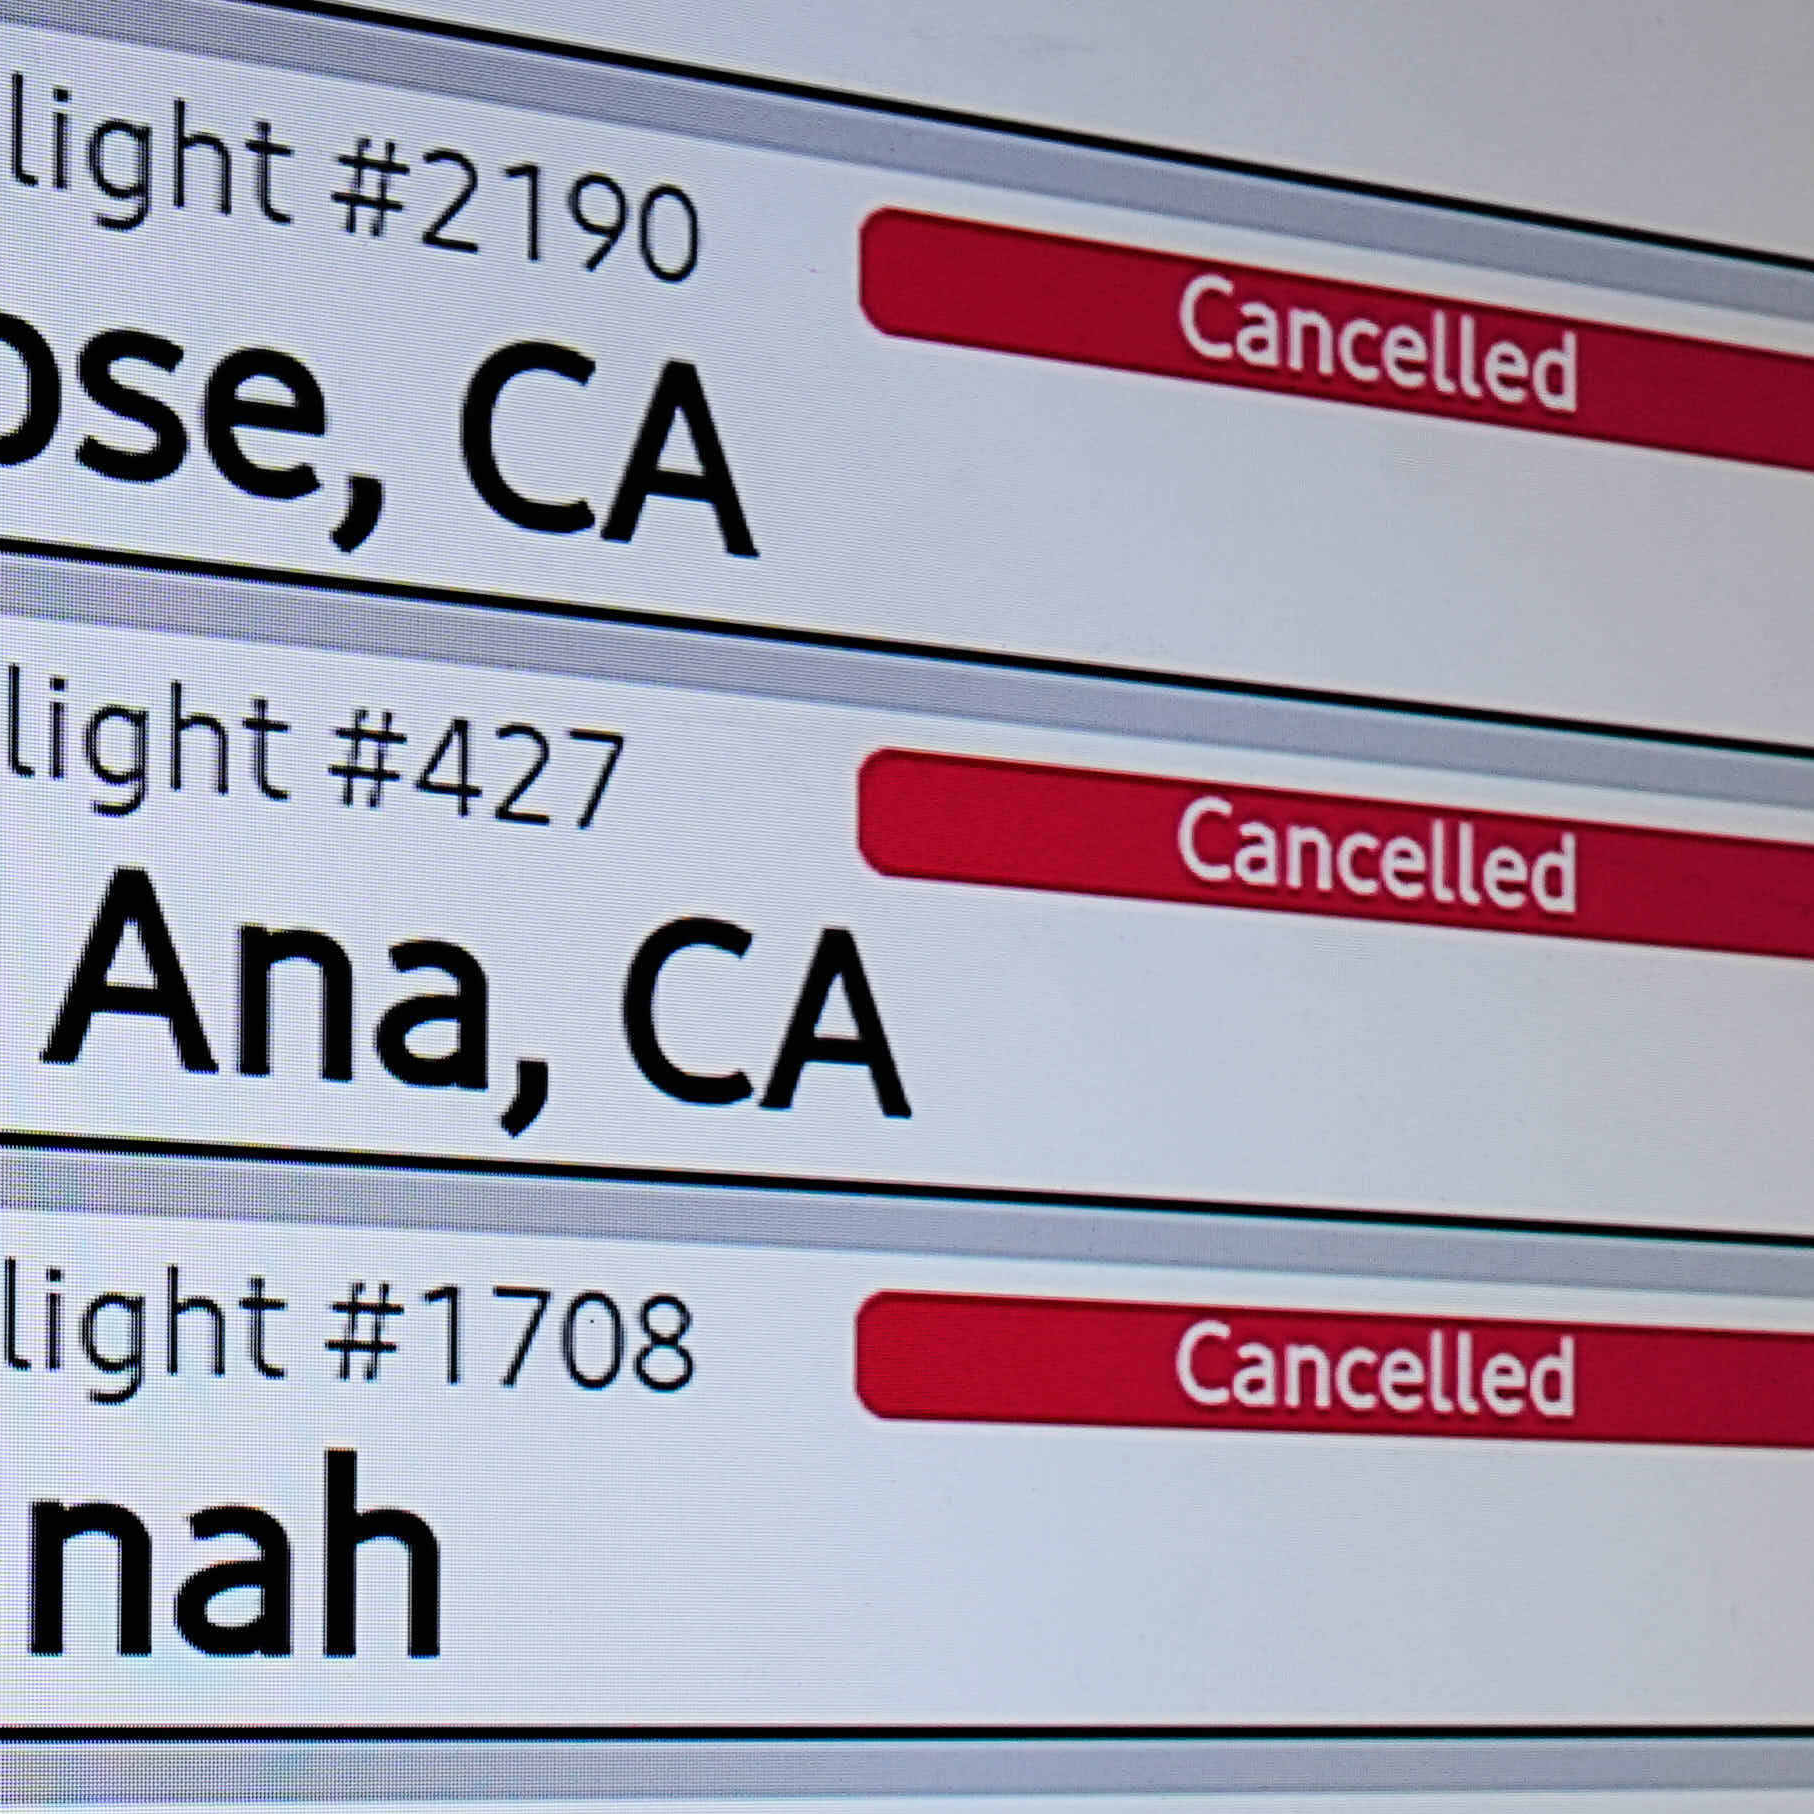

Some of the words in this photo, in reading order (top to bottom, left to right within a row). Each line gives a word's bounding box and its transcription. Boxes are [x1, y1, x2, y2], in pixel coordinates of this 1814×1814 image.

[331, 138, 700, 284] #2190
[1180, 274, 1577, 411] Cancelled
[460, 341, 759, 558] CA
[329, 709, 625, 829] #427
[1178, 797, 1576, 914] Cancelled
[40, 867, 549, 1137] Ana,
[622, 917, 912, 1119] CA
[325, 1282, 695, 1393] #1708
[1177, 1320, 1574, 1416] Cancelled
